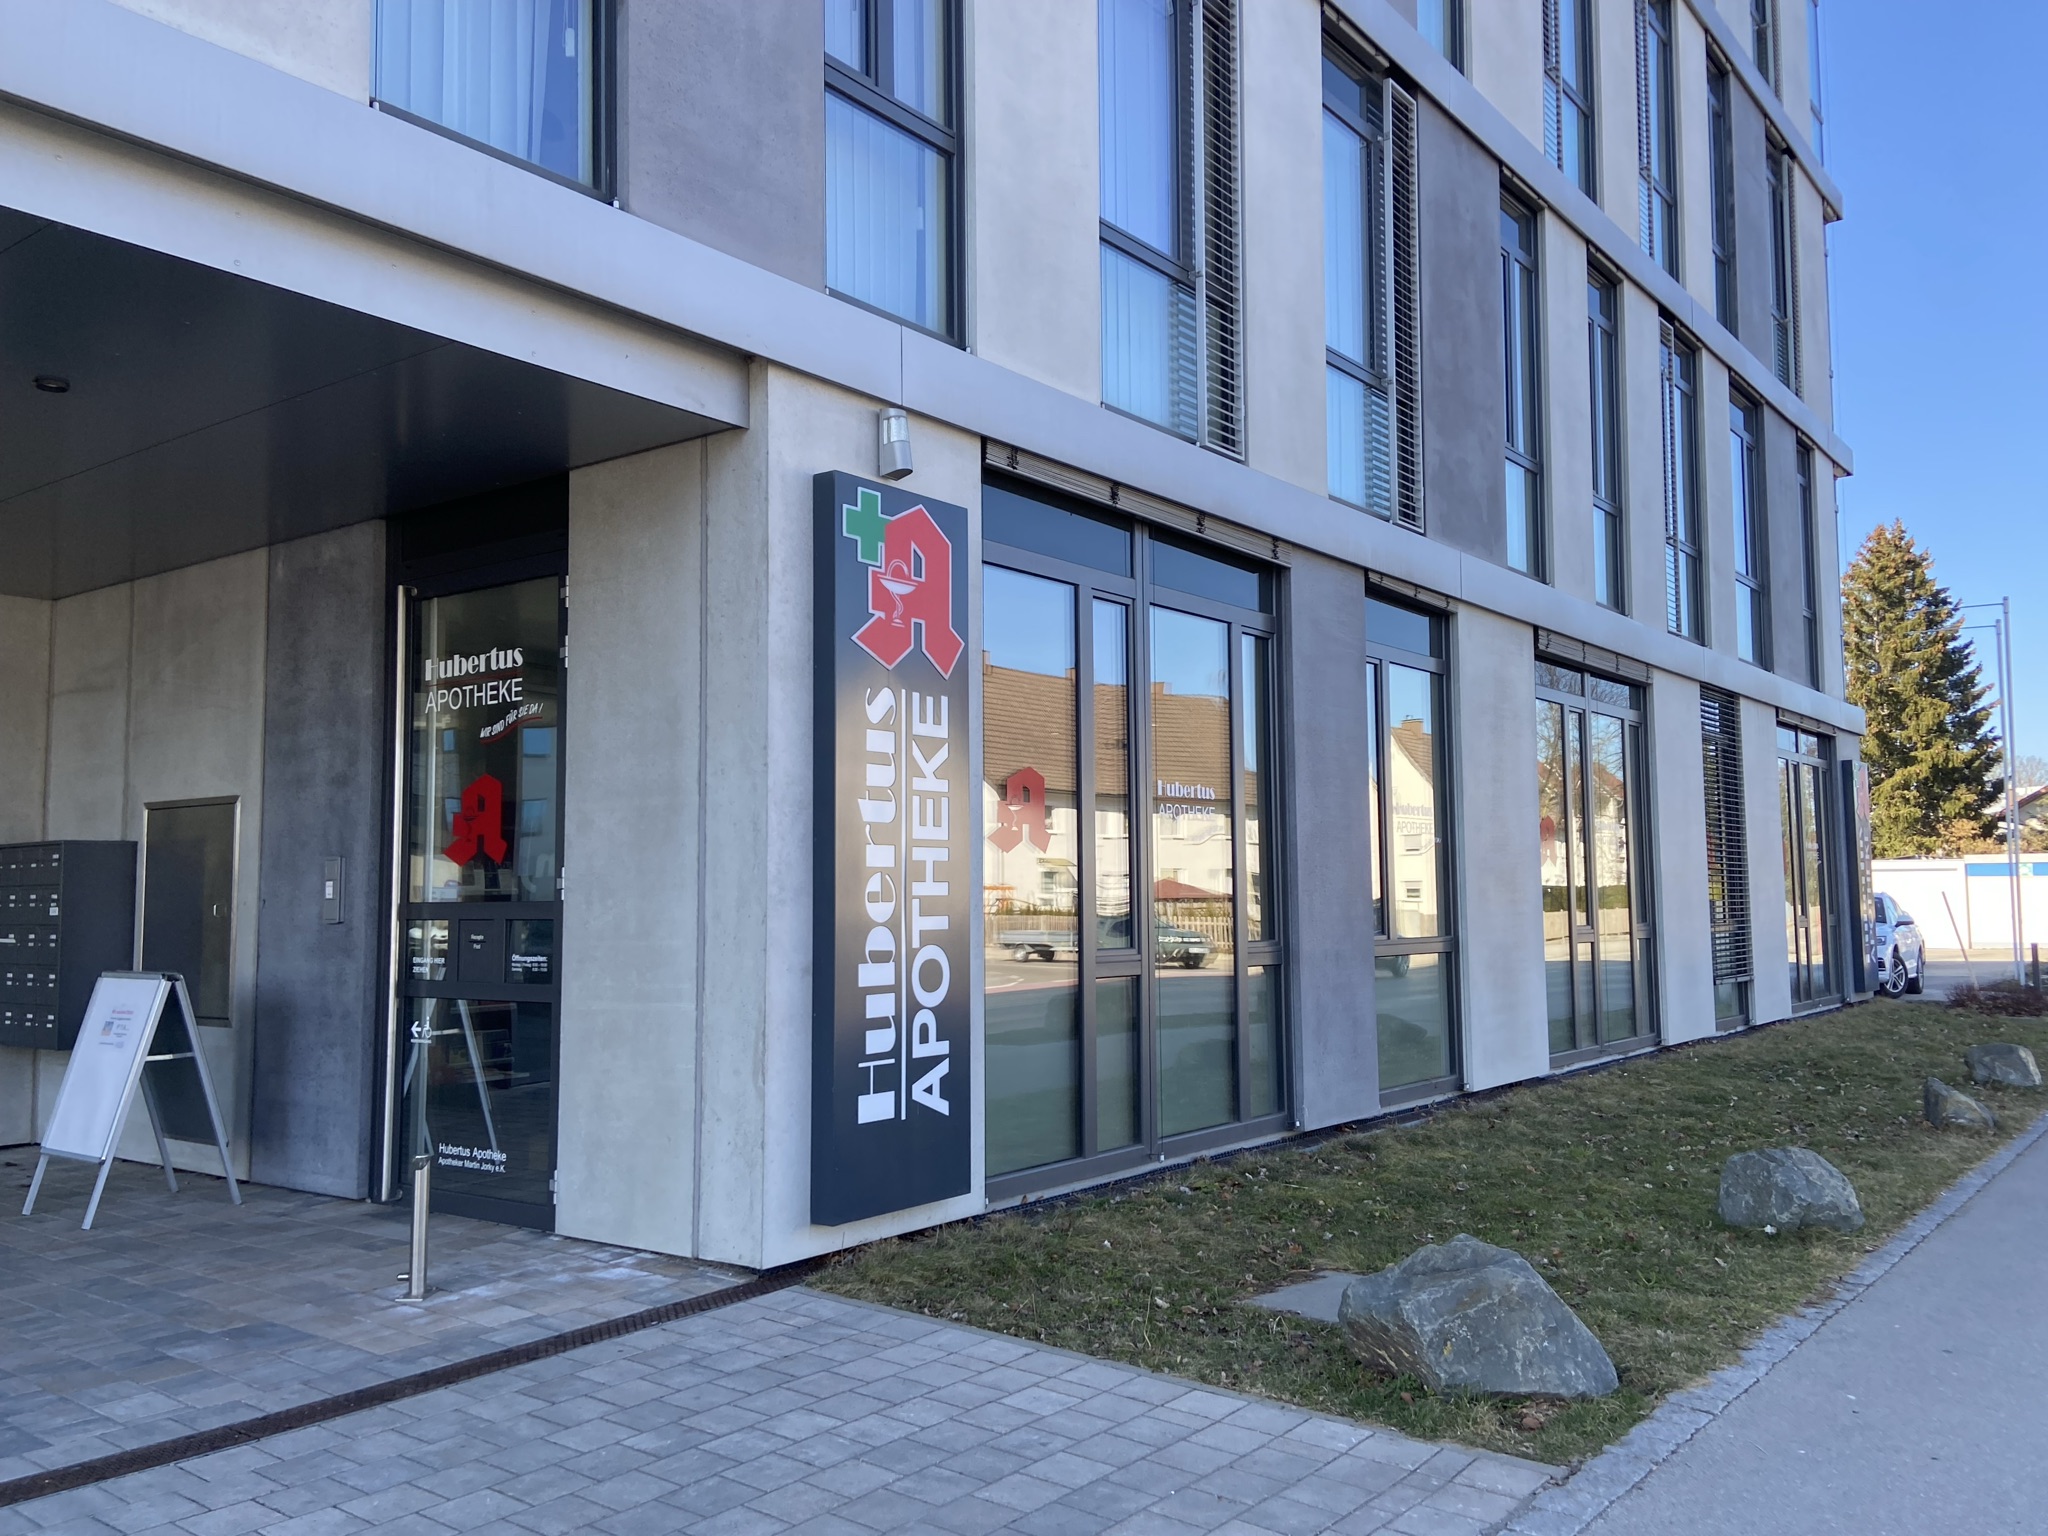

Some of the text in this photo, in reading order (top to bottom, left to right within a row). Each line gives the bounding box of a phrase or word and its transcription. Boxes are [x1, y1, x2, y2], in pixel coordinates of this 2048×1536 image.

[425, 647, 523, 681] Hubertus
[425, 677, 523, 714] APOTHEKE
[480, 726, 492, 738] WIR
[491, 720, 505, 736] SIND
[505, 709, 518, 727] FÜR
[518, 704, 530, 718] SIE
[1157, 780, 1216, 800] Hubertus
[858, 687, 897, 1124] Hubertus
[912, 692, 950, 1116] APOTHEKE
[438, 1143, 507, 1161] Hubertus Apotheke
